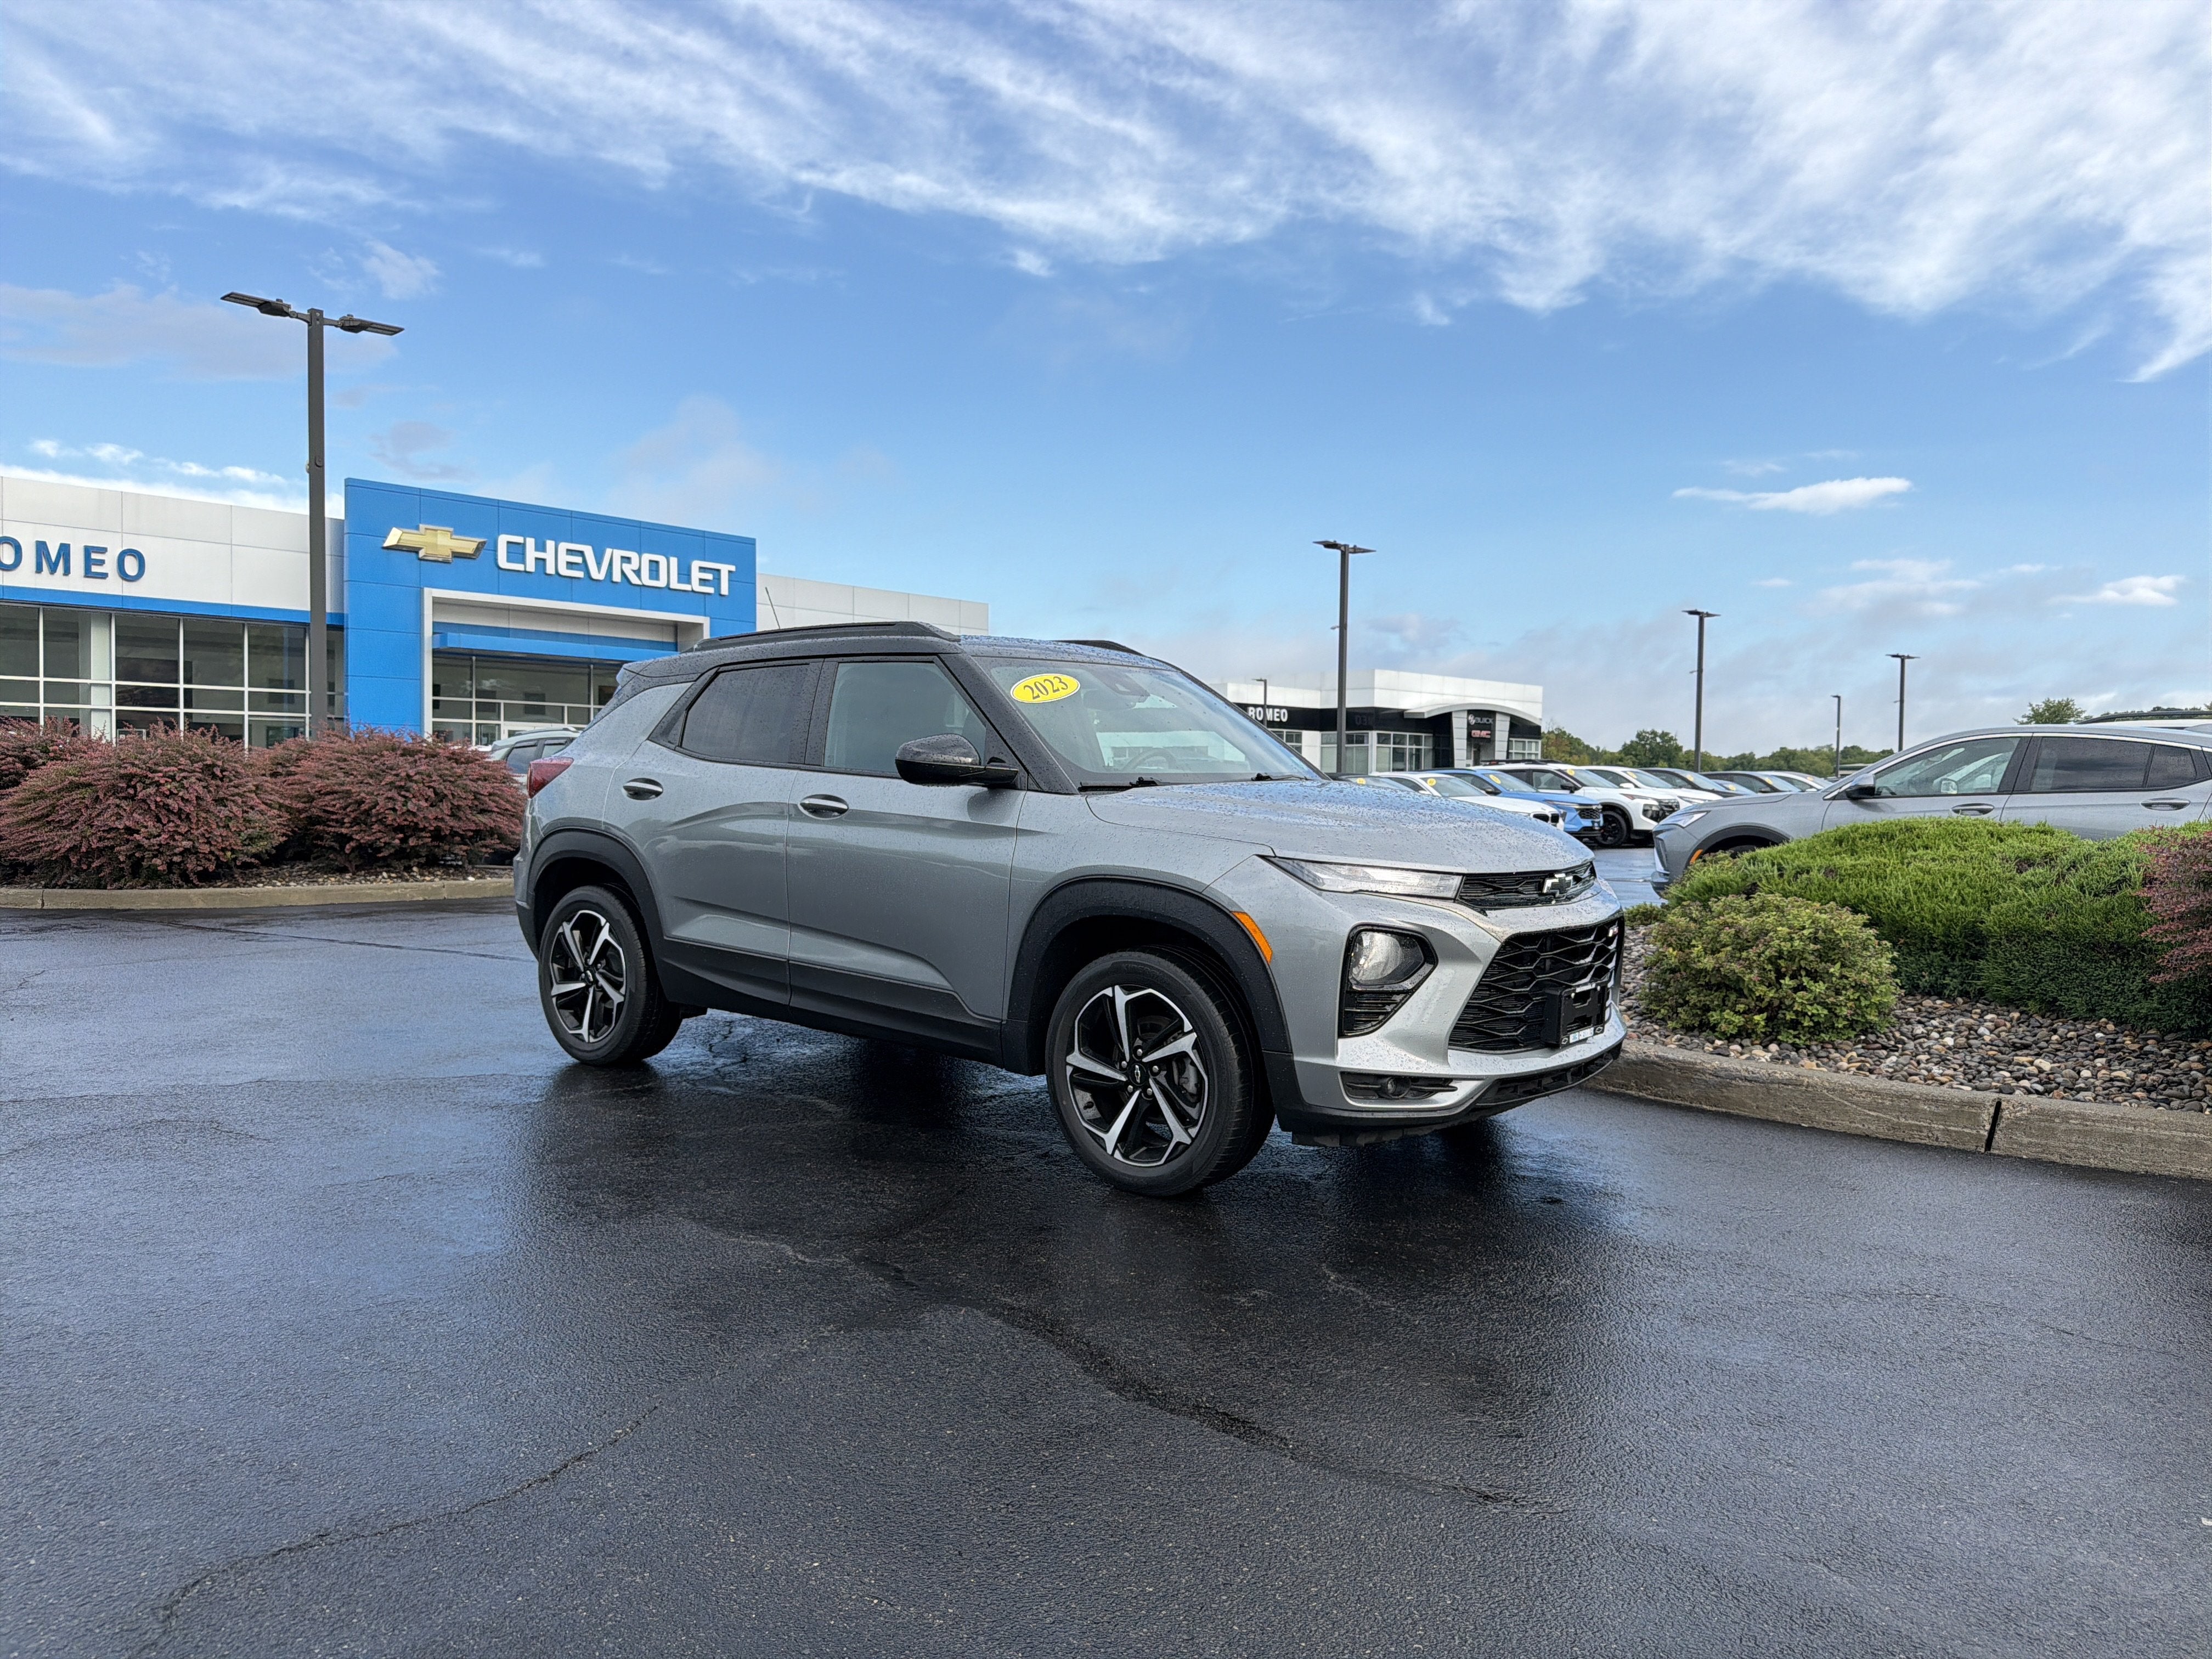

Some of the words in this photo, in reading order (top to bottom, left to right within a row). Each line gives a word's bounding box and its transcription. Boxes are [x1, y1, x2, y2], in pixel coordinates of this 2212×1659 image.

[0, 535, 146, 582] OMEO
[497, 534, 736, 596] CHEVROLET
[1024, 676, 1068, 699] 2023
[1247, 706, 1288, 722] ROMEO
[1471, 730, 1491, 738] GMC
